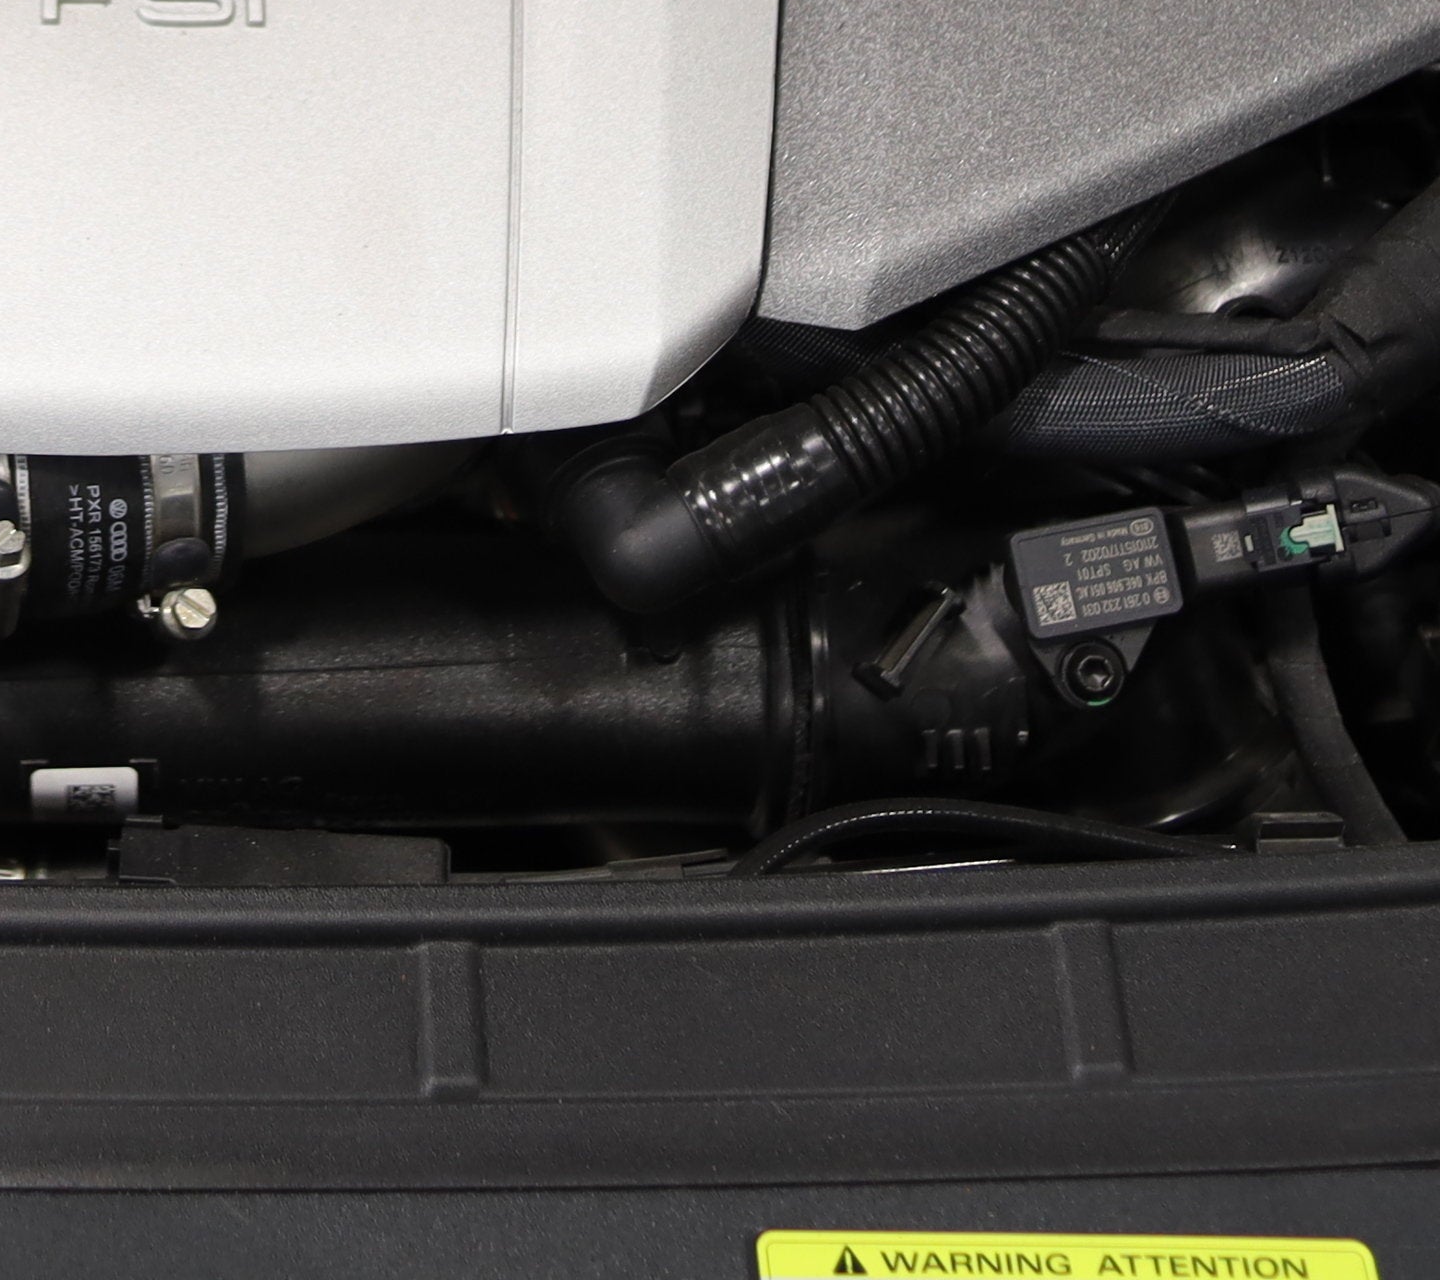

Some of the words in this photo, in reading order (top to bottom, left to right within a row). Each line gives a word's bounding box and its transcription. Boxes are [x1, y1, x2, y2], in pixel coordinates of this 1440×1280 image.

[86, 485, 102, 524] PXR
[1063, 552, 1074, 567] 2
[1122, 559, 1140, 572] AG
[1144, 553, 1164, 567] VW
[881, 1251, 1071, 1275] WARNING
[1097, 1254, 1309, 1279] ATTENTION
